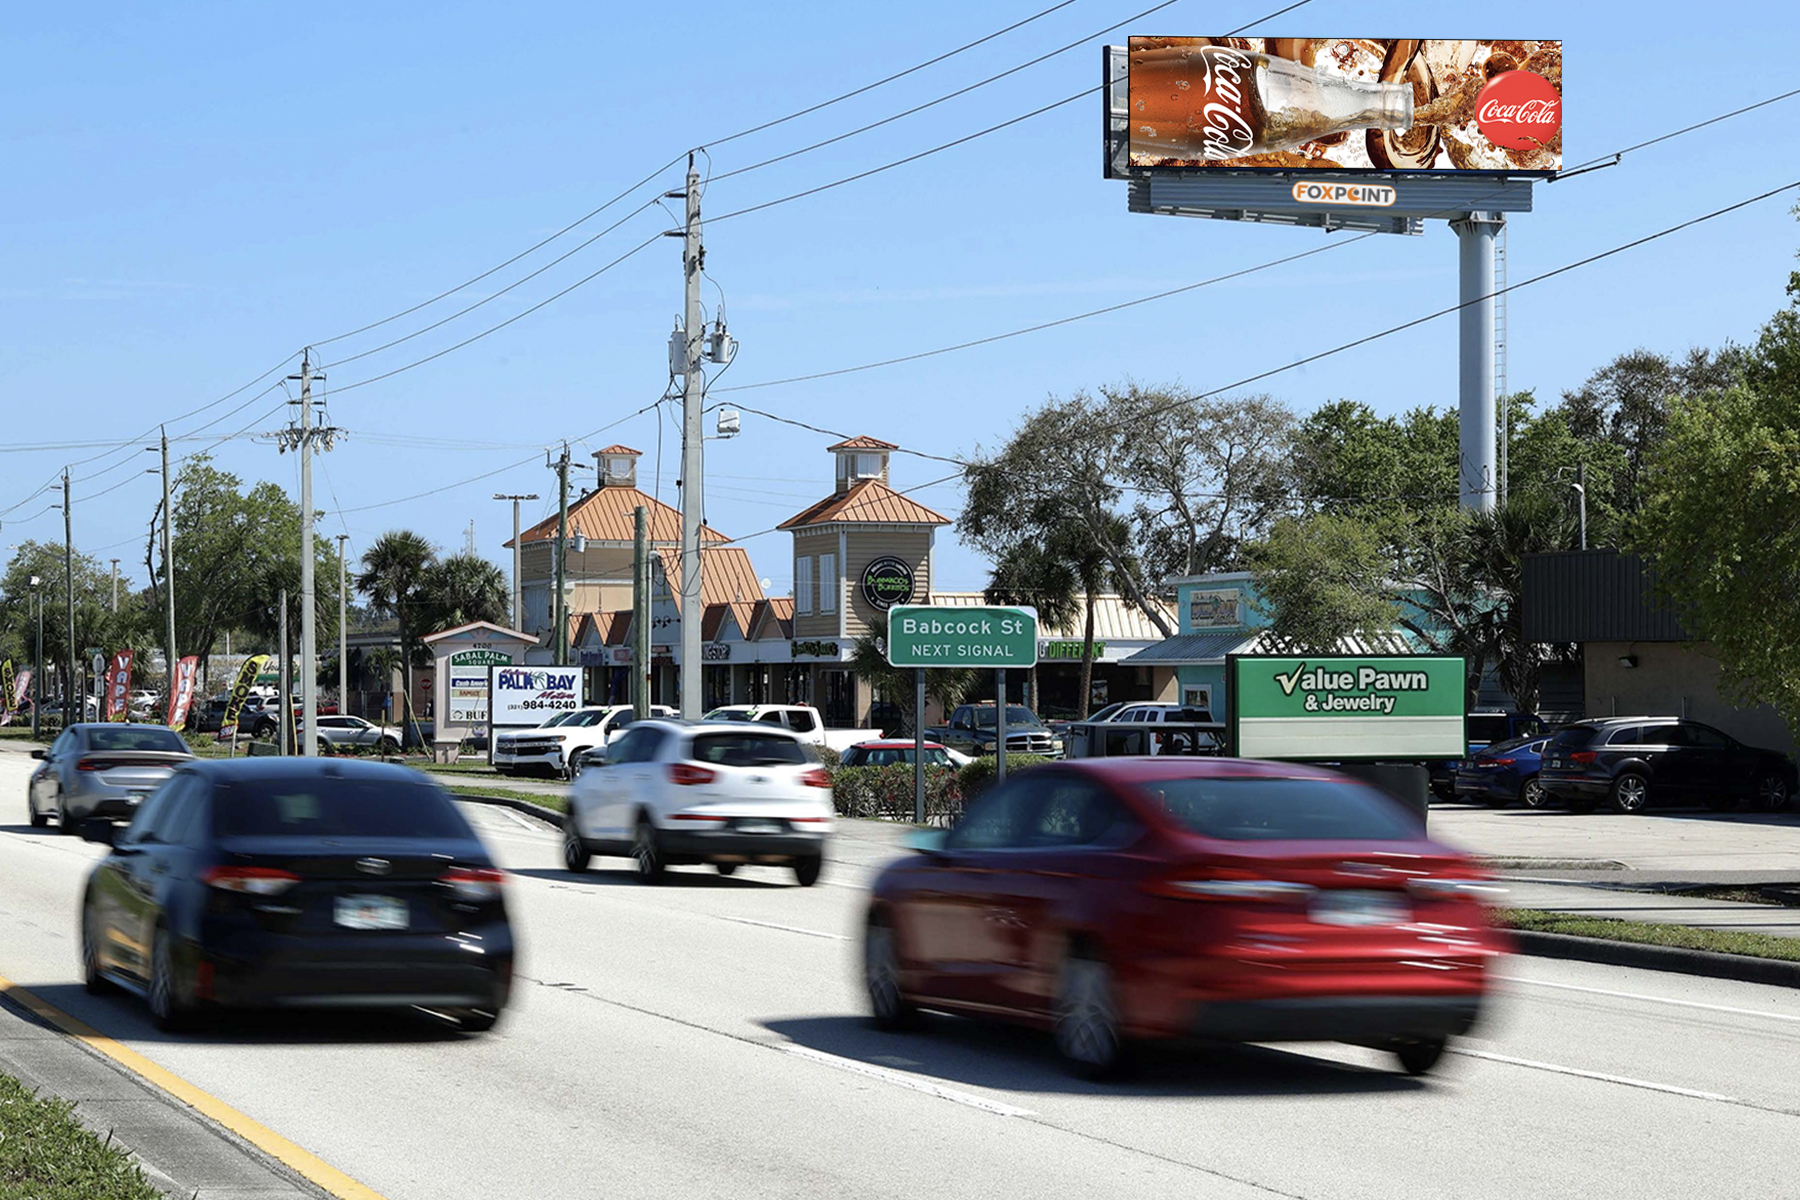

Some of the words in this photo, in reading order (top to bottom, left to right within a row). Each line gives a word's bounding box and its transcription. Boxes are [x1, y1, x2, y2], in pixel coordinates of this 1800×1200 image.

[1201, 45, 1253, 159] Coca-Cola
[1479, 99, 1559, 124] Coca-Cola
[1297, 184, 1393, 203] FOXPOINT
[903, 619, 991, 634] Babcock
[1001, 619, 1023, 635] St
[454, 651, 482, 663] SABAL
[484, 651, 508, 662] PALM
[912, 645, 951, 656] NEXT
[957, 645, 1014, 656] SIGNAL
[1048, 641, 1106, 658] DIFFERNT
[115, 654, 130, 711] VAPE
[498, 673, 534, 690] PALM
[547, 675, 577, 690] BAY
[1275, 663, 1354, 694] Value
[1358, 668, 1427, 689] Pawn
[173, 663, 193, 722] VAPE
[1305, 694, 1318, 710] &
[1322, 693, 1395, 713] Jewelry
